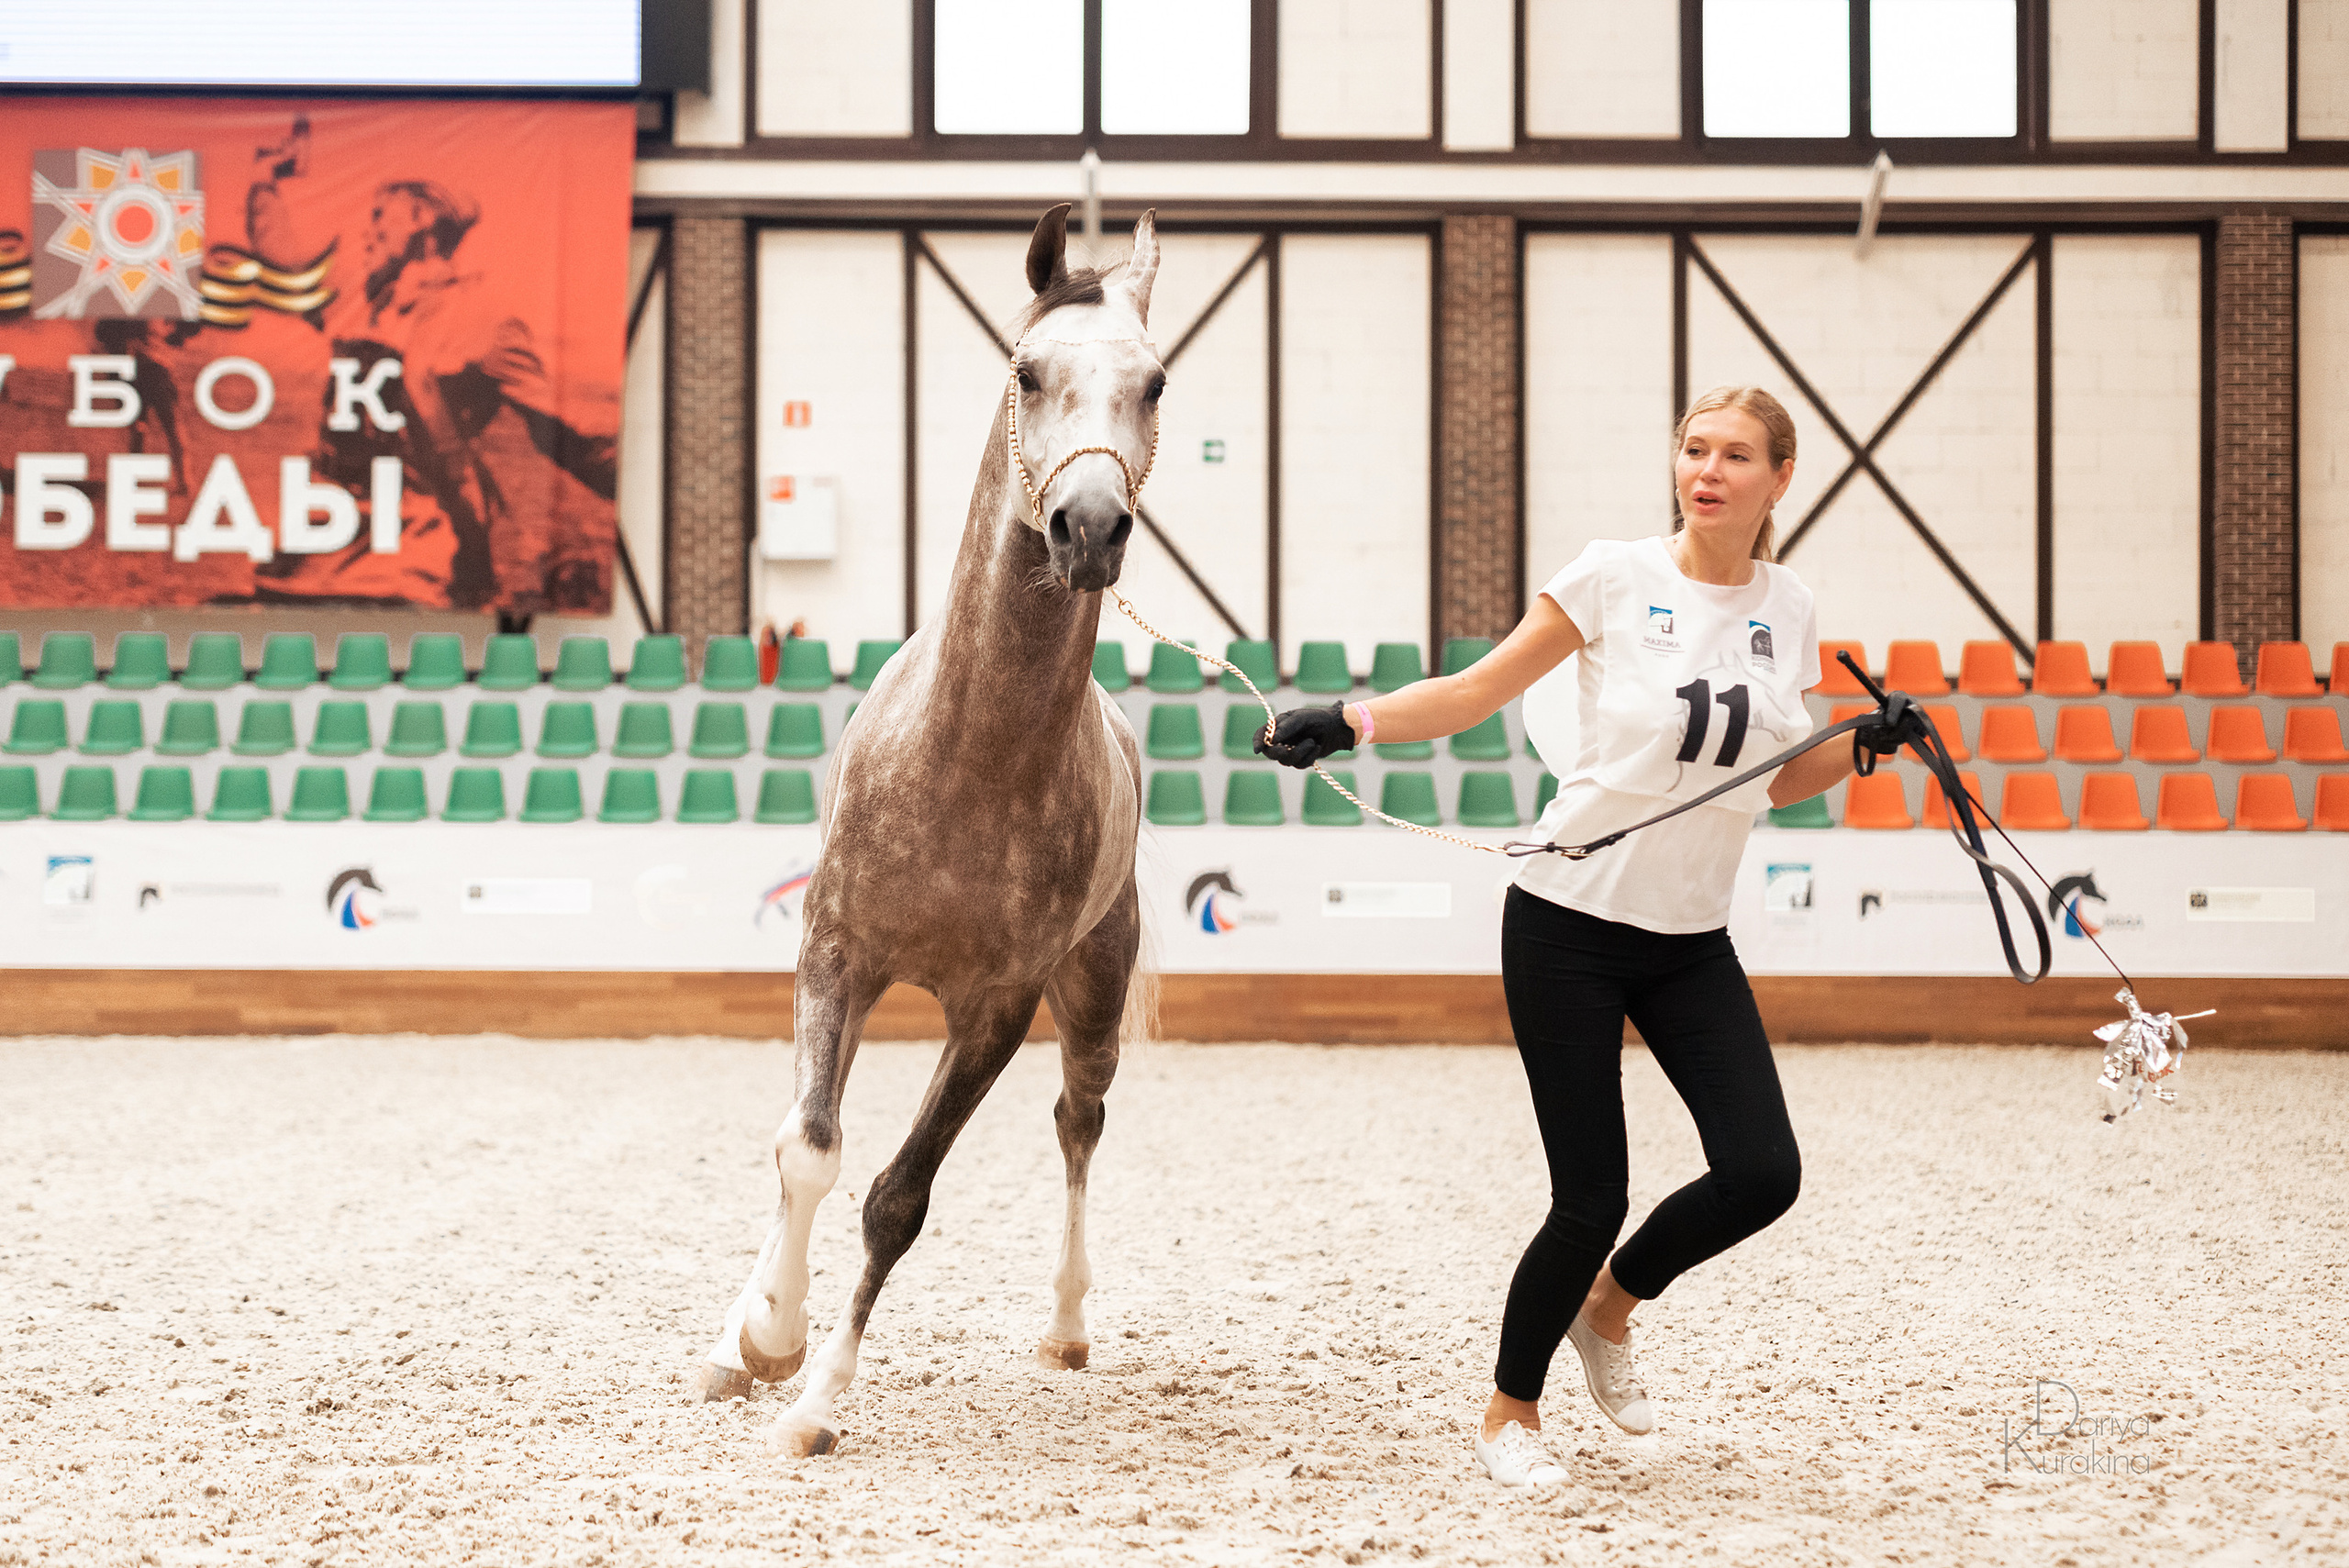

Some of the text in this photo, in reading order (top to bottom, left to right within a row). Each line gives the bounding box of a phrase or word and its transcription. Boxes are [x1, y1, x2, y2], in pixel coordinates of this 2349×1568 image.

[0, 354, 406, 432] БОК
[0, 452, 403, 562] БЕДЫ
[1643, 636, 1681, 649] MAXIMA
[1675, 678, 1750, 768] 11
